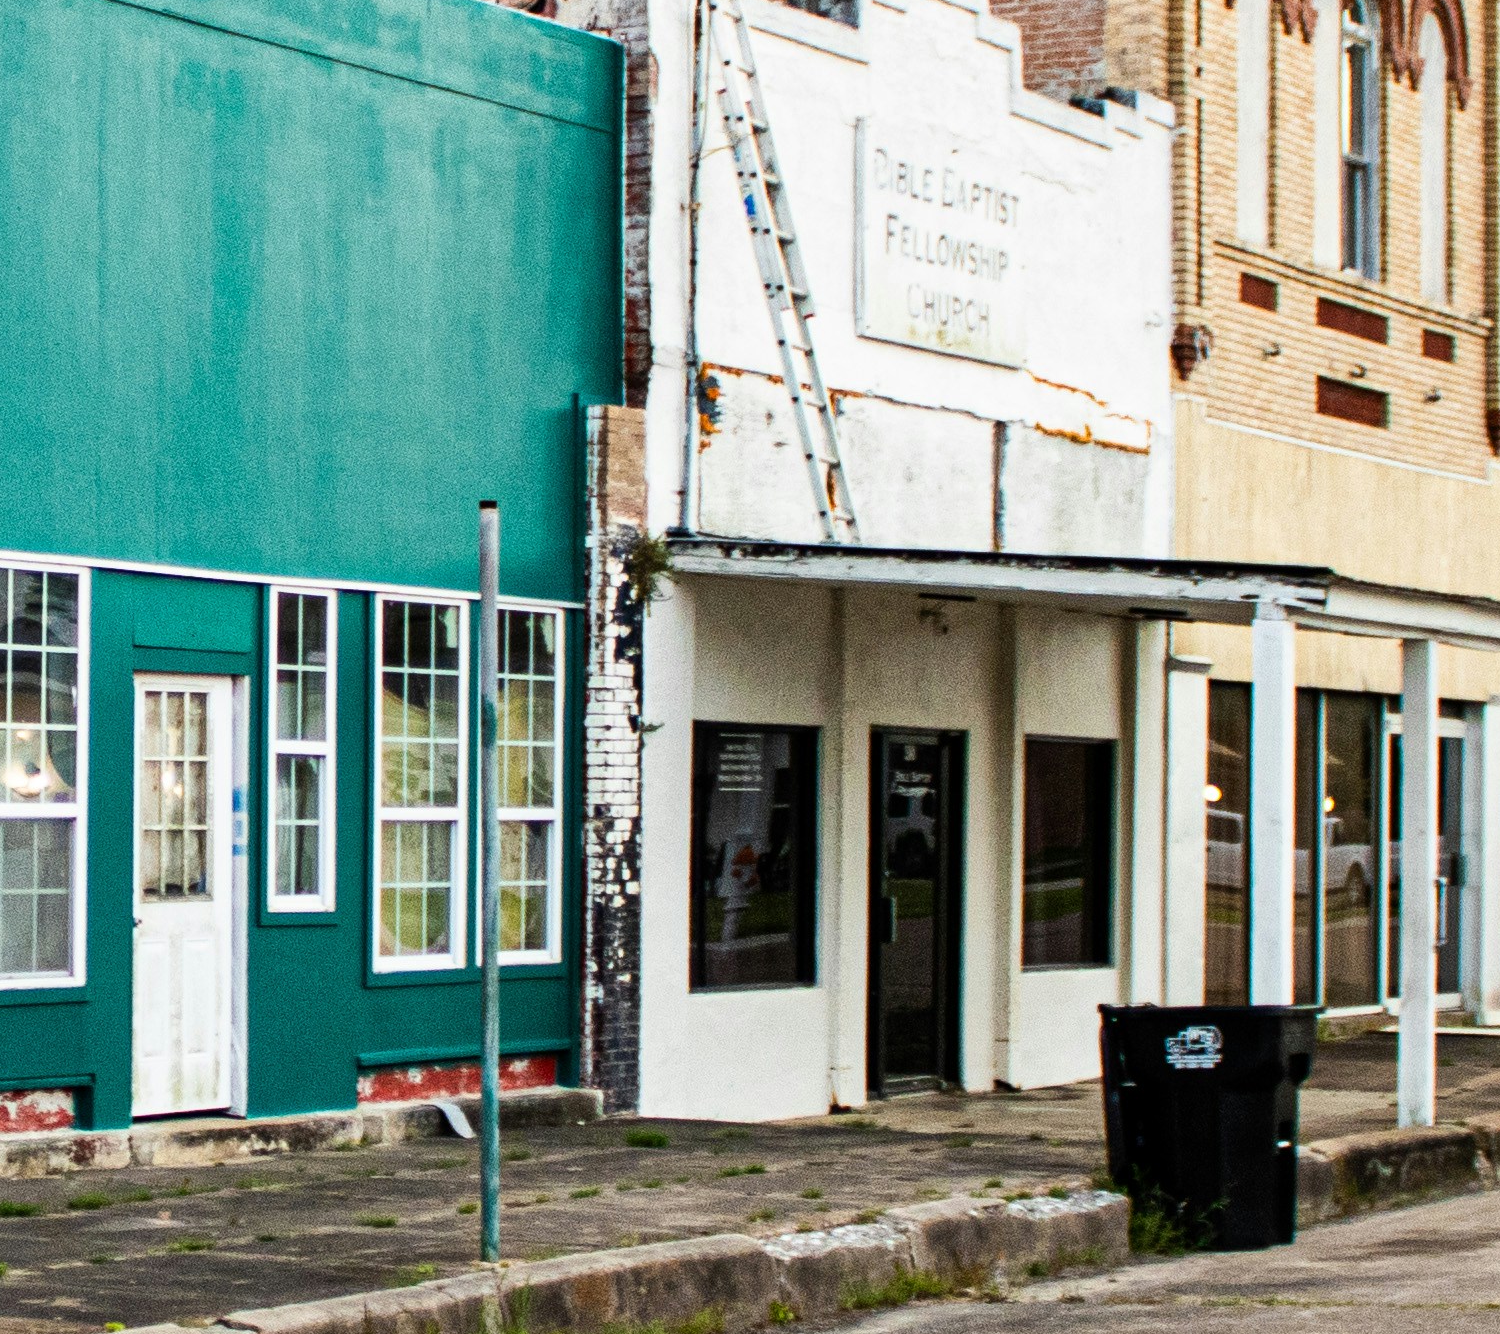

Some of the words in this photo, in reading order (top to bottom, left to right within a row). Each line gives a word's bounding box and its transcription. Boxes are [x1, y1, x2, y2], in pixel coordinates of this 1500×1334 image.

[873, 147, 933, 203] BIBLE
[941, 168, 1019, 228] BAPTIST
[886, 213, 1009, 282] FELLOWSHIP
[907, 283, 990, 337] CHURCH
